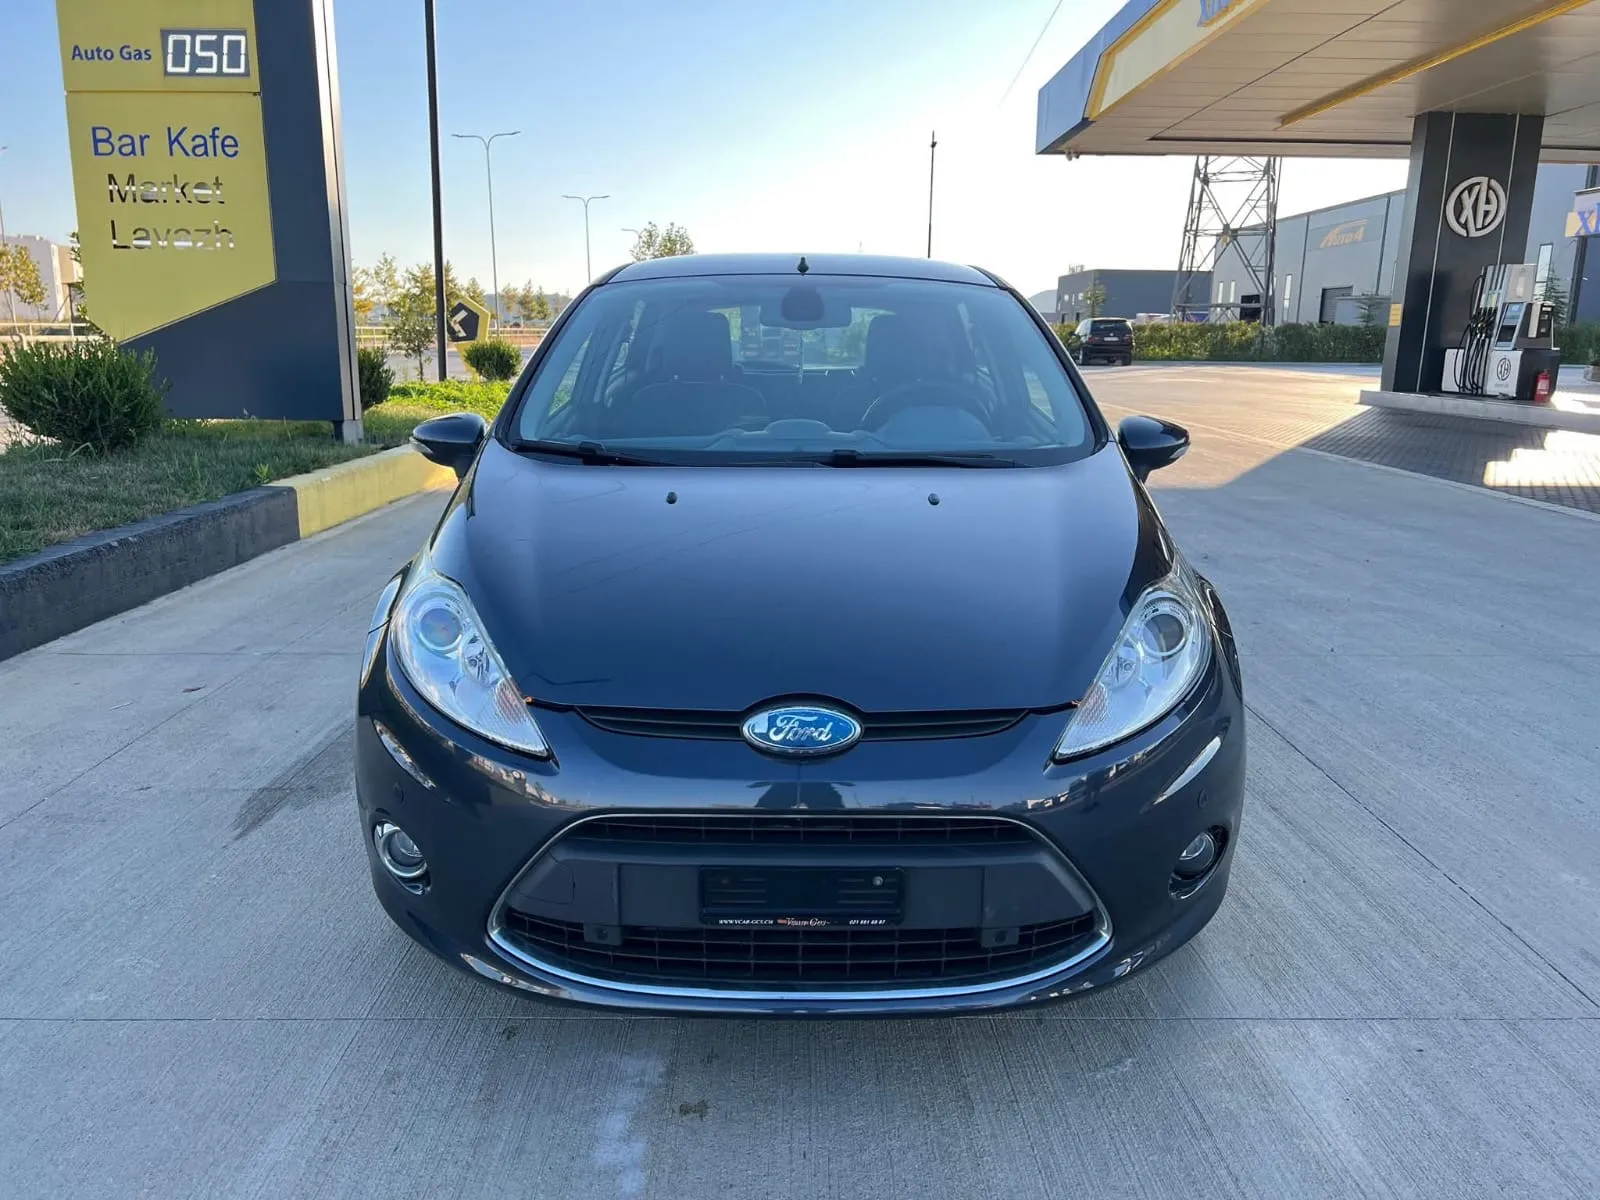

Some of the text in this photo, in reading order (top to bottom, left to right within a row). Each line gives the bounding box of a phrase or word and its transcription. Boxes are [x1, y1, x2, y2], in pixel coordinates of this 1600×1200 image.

[71, 45, 152, 61] Auto Gas
[167, 34, 246, 74] 050
[91, 126, 239, 158] Bar Kafe
[107, 173, 225, 204] Market
[110, 219, 235, 250] Lavazh
[769, 714, 833, 741] Ford
